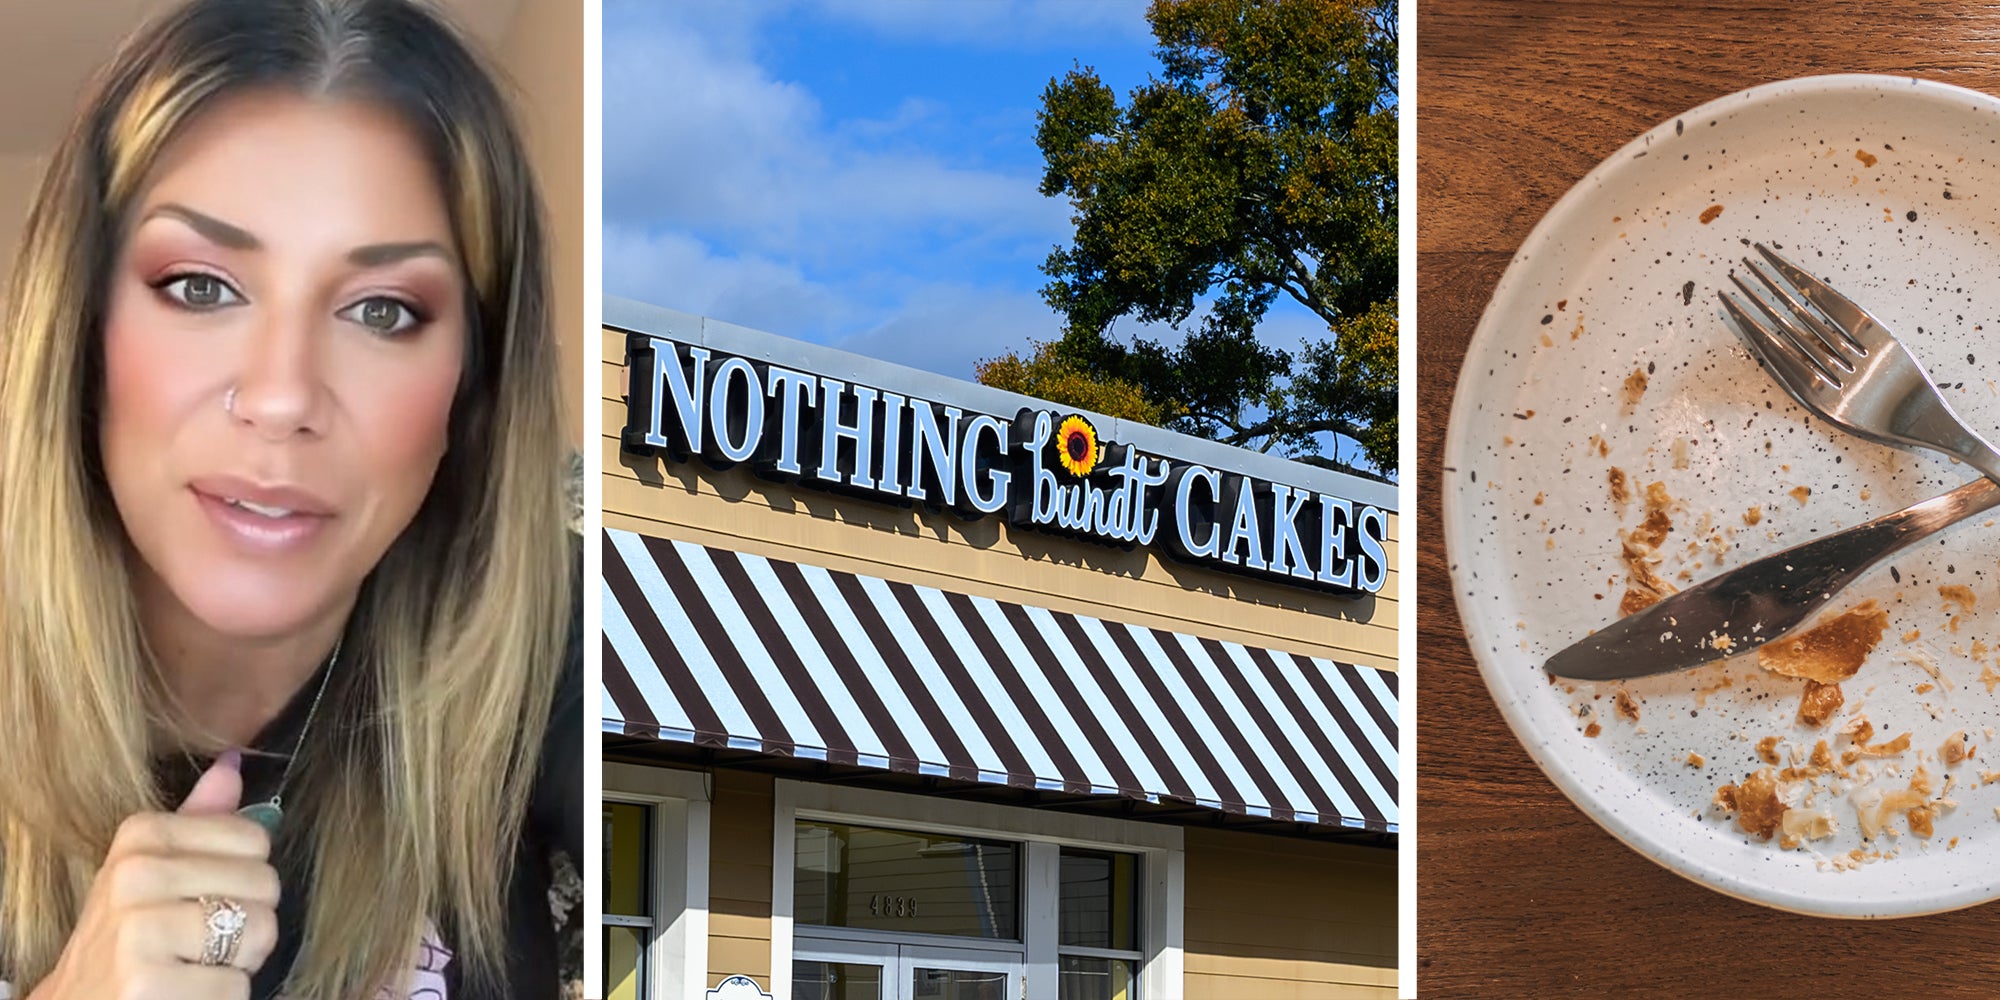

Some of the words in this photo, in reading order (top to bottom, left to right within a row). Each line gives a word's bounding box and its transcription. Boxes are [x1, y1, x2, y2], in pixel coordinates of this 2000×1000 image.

[645, 337, 1012, 514] NOTHING
[1023, 410, 1170, 546] bundt
[1175, 465, 1388, 594] CAKES
[870, 894, 918, 918] 4839
